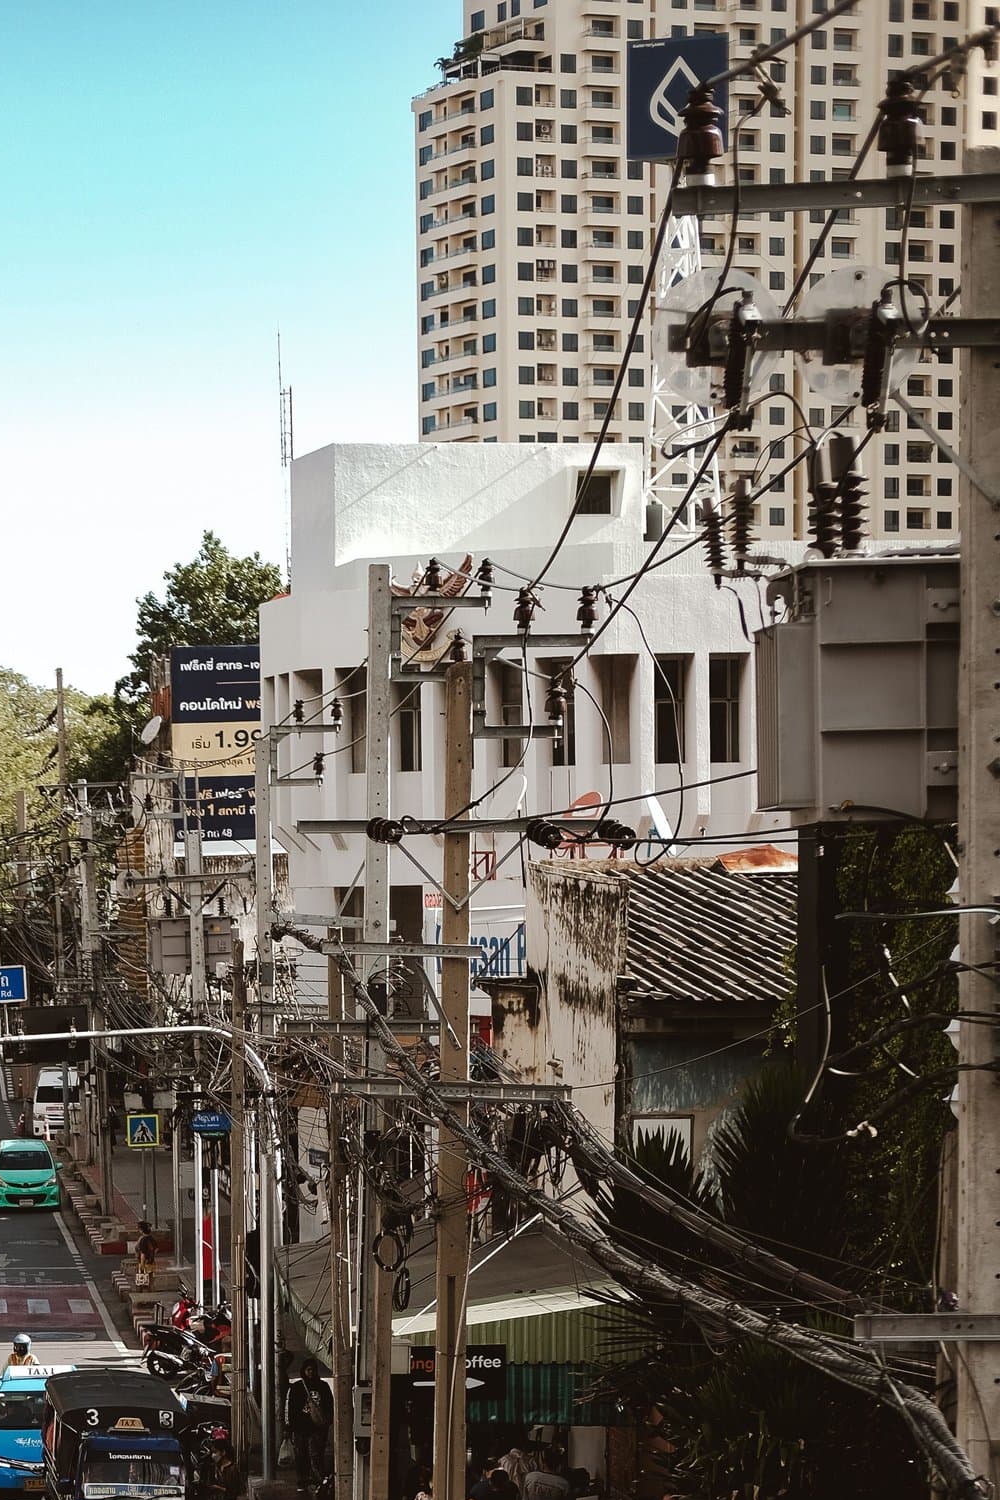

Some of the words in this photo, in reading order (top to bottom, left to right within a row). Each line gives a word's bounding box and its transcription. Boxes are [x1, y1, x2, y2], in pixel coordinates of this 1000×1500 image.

[179, 697, 242, 712] คอนโดใหม่
[191, 735, 211, 749] เริ่ม
[207, 803, 215, 816] 1
[218, 805, 246, 816] สถานี
[221, 828, 233, 838] 48
[465, 1355, 502, 1369] offee
[27, 1367, 55, 1375] TAXI
[86, 1408, 100, 1426] 3
